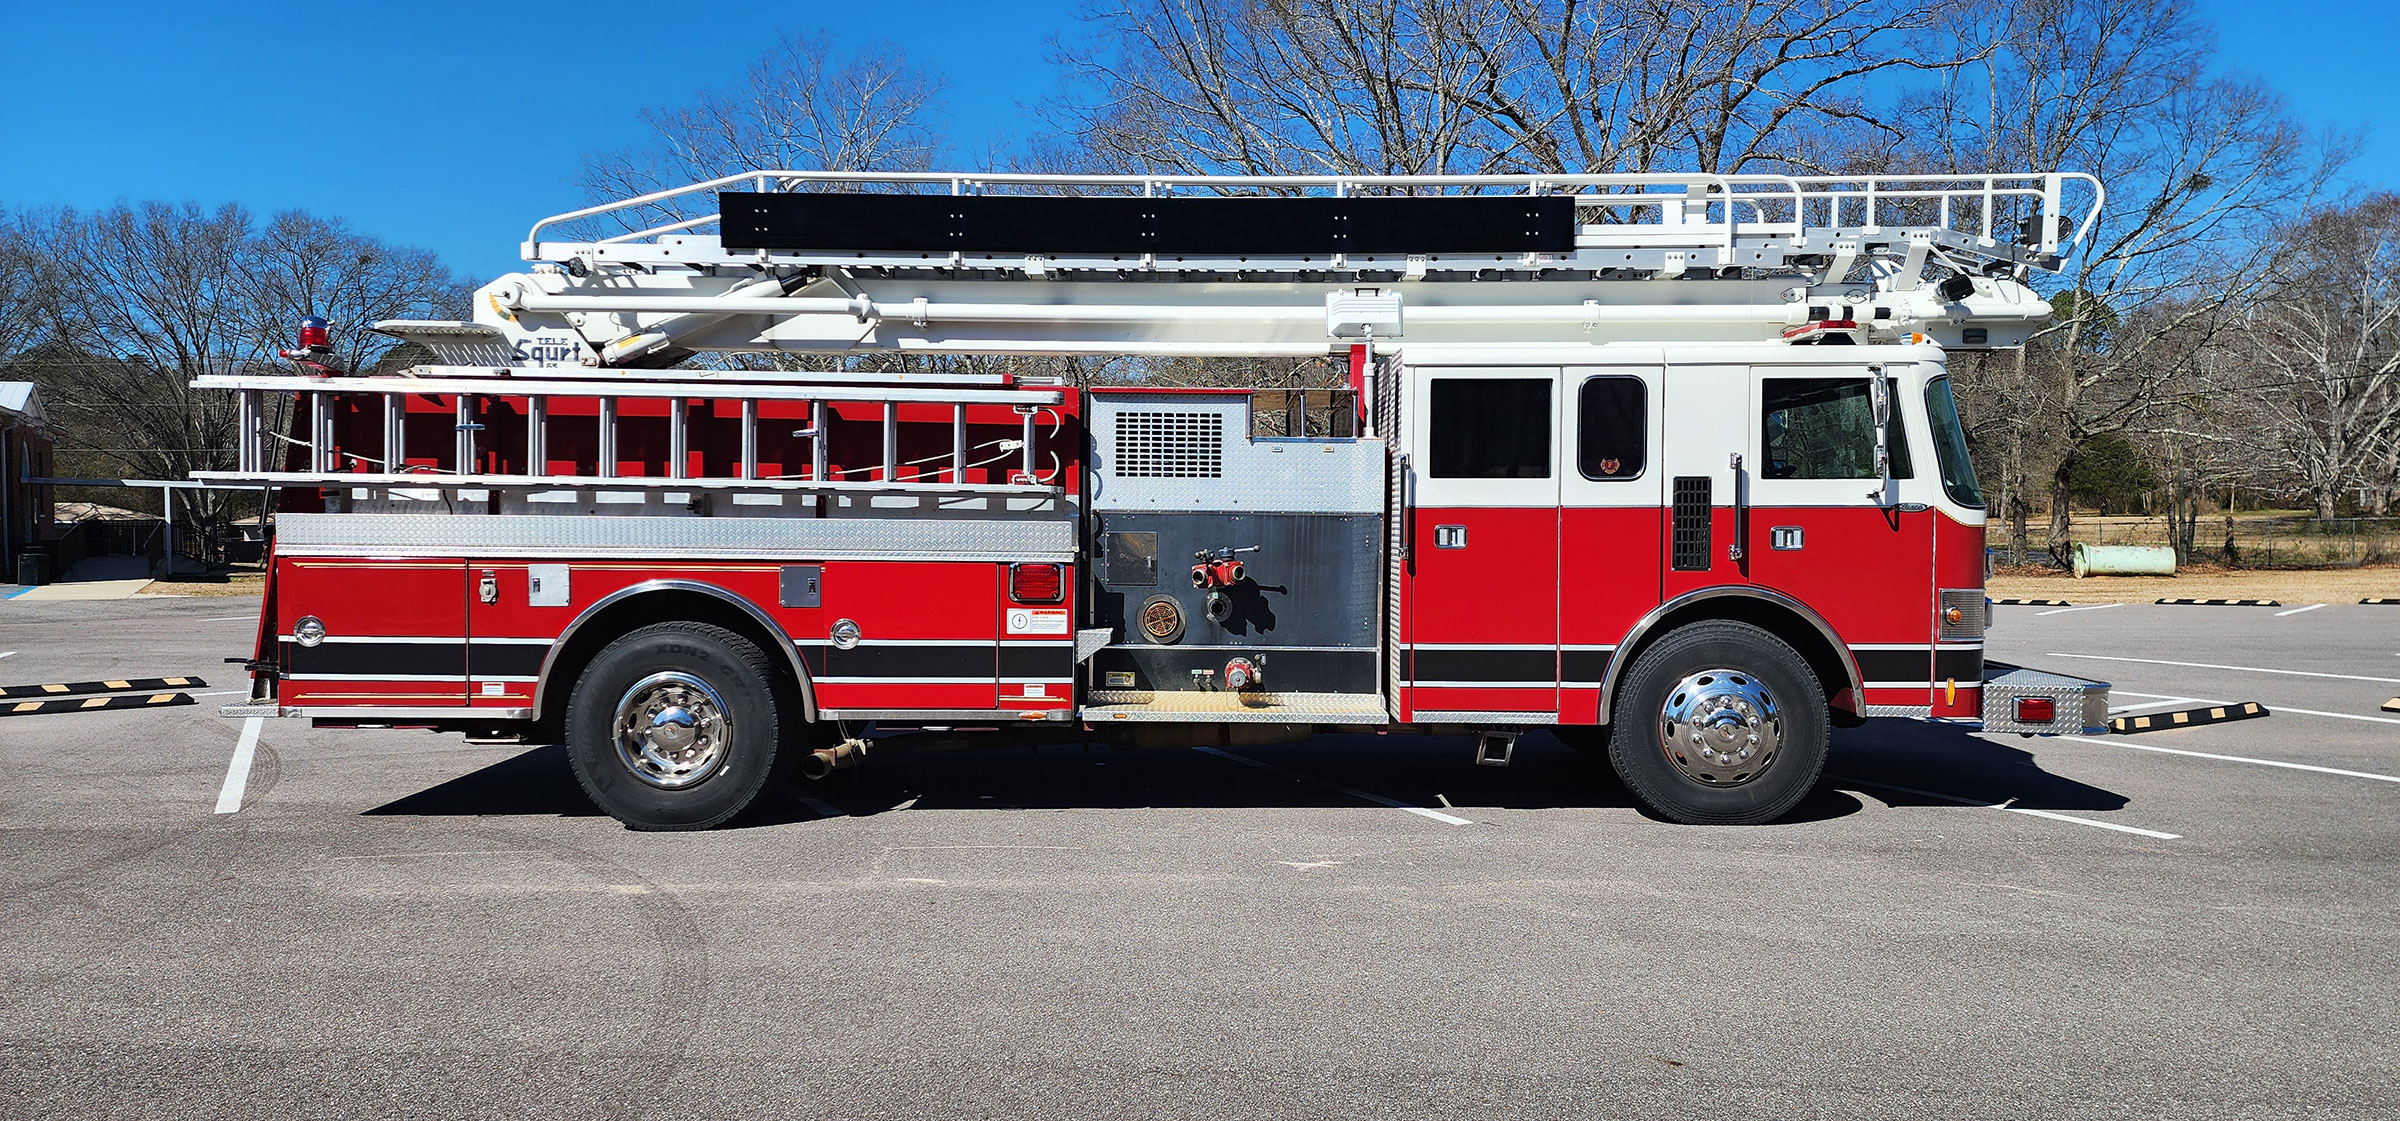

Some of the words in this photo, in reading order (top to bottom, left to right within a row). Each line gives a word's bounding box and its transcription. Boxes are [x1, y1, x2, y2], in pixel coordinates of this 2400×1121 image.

[536, 337, 568, 345] TELE
[512, 339, 581, 368] Squrt
[654, 643, 710, 662] XDN2
